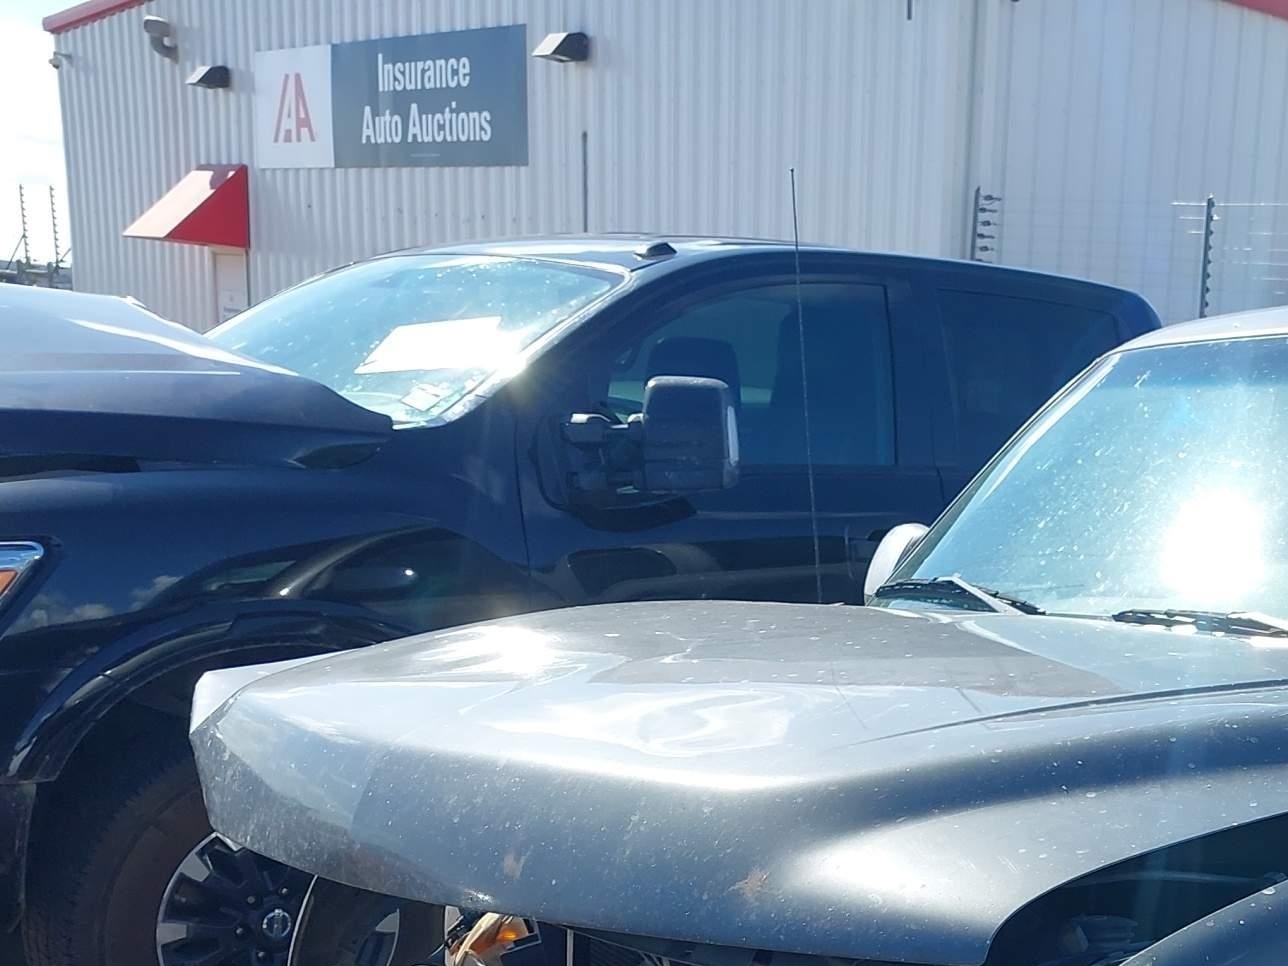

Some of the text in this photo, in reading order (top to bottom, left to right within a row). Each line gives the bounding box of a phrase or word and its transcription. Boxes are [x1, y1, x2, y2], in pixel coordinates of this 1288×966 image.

[377, 52, 471, 93] Insurance
[361, 101, 492, 145] Auto Auctions
